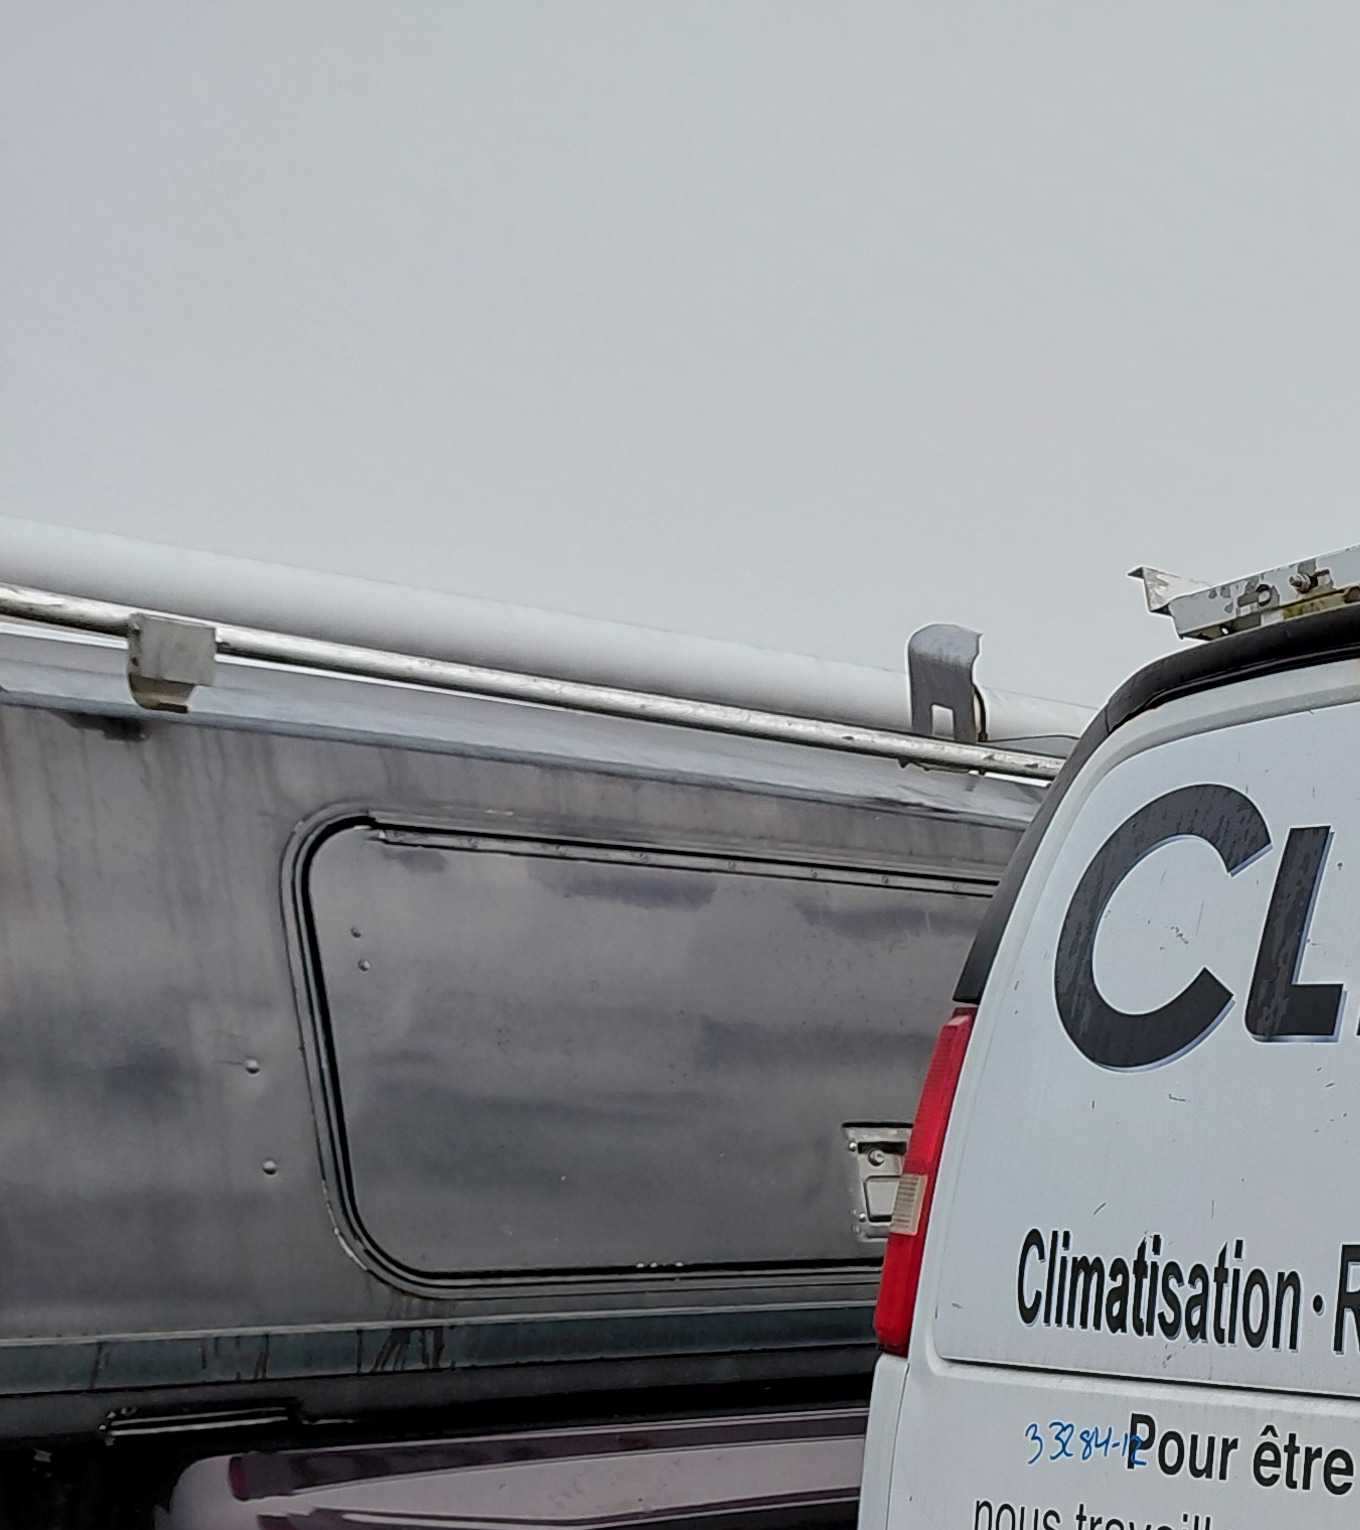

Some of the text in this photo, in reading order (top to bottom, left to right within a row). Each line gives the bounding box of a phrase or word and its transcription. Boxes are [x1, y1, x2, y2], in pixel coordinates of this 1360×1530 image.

[1016, 1228, 1300, 1352] Climatisation
[1127, 1412, 1239, 1481] Pour
[1253, 1426, 1354, 1497] être
